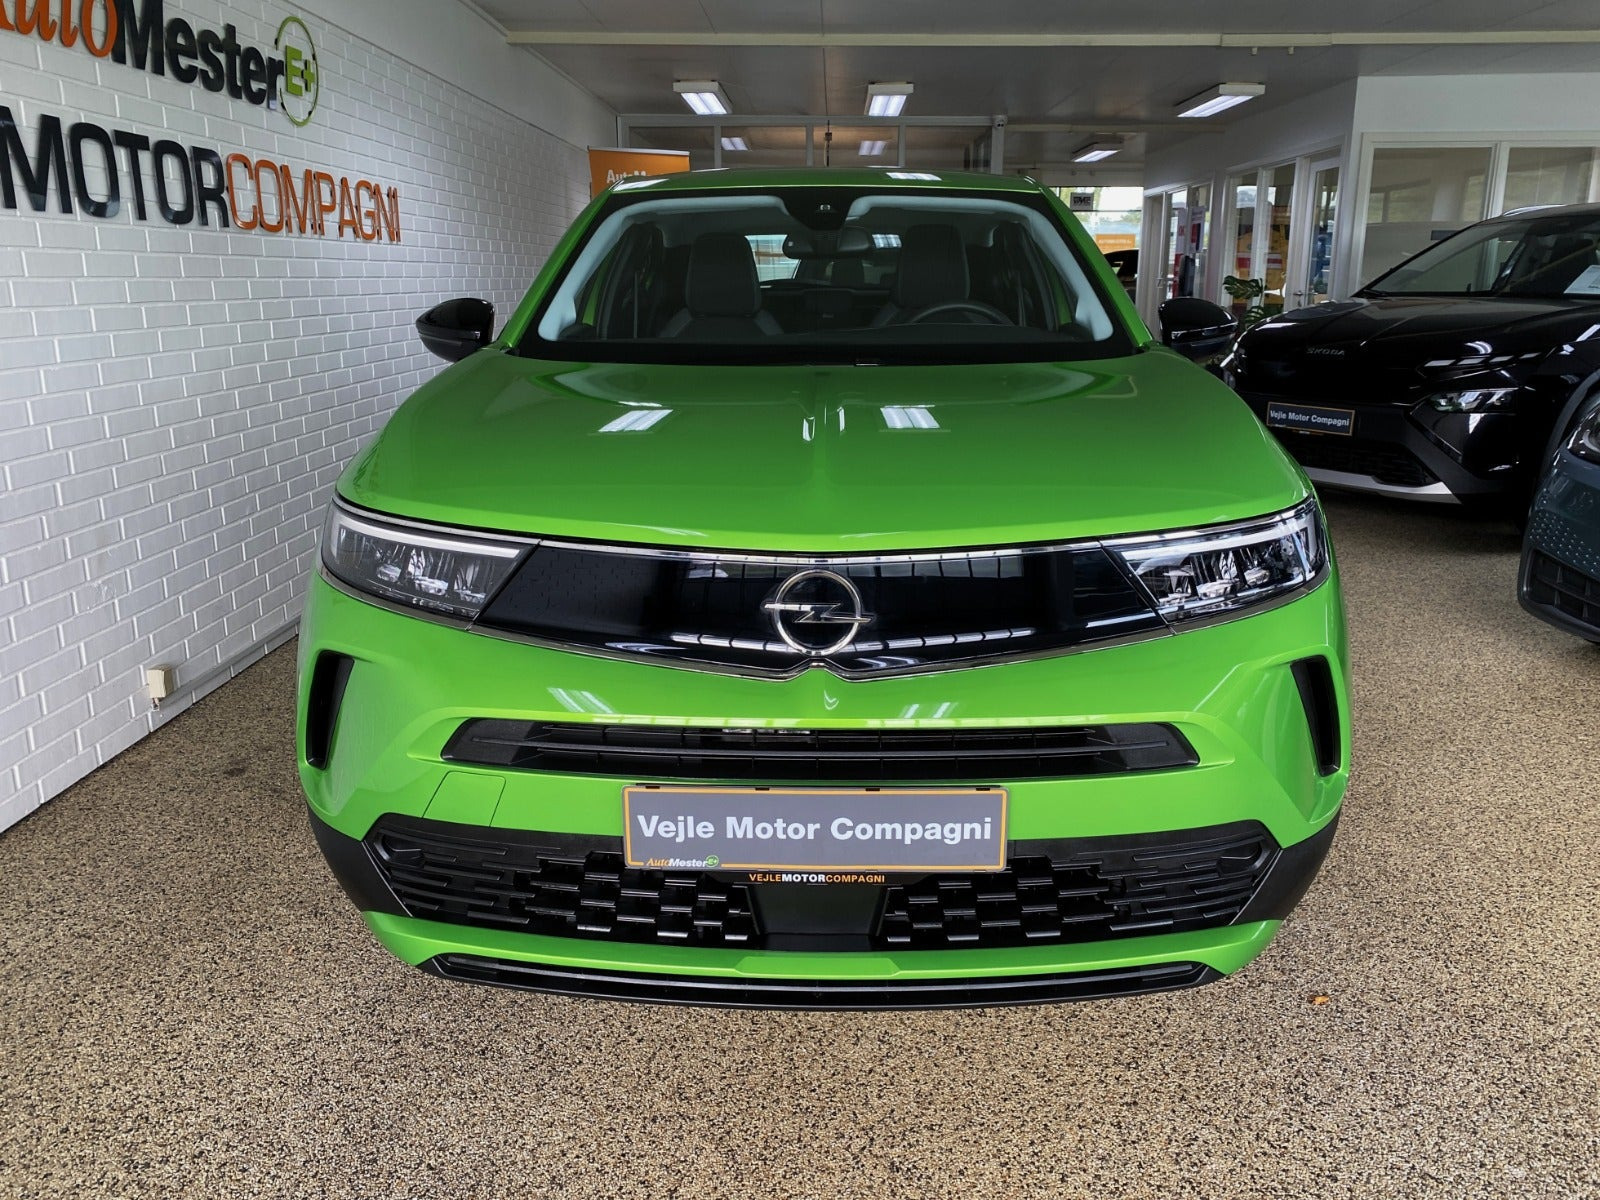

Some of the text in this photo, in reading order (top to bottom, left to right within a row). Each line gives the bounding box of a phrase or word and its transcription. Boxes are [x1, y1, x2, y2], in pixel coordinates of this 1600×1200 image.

[1270, 410, 1350, 427] Vejle Motor Compagni
[637, 815, 992, 845] Vejle Motor Compagni
